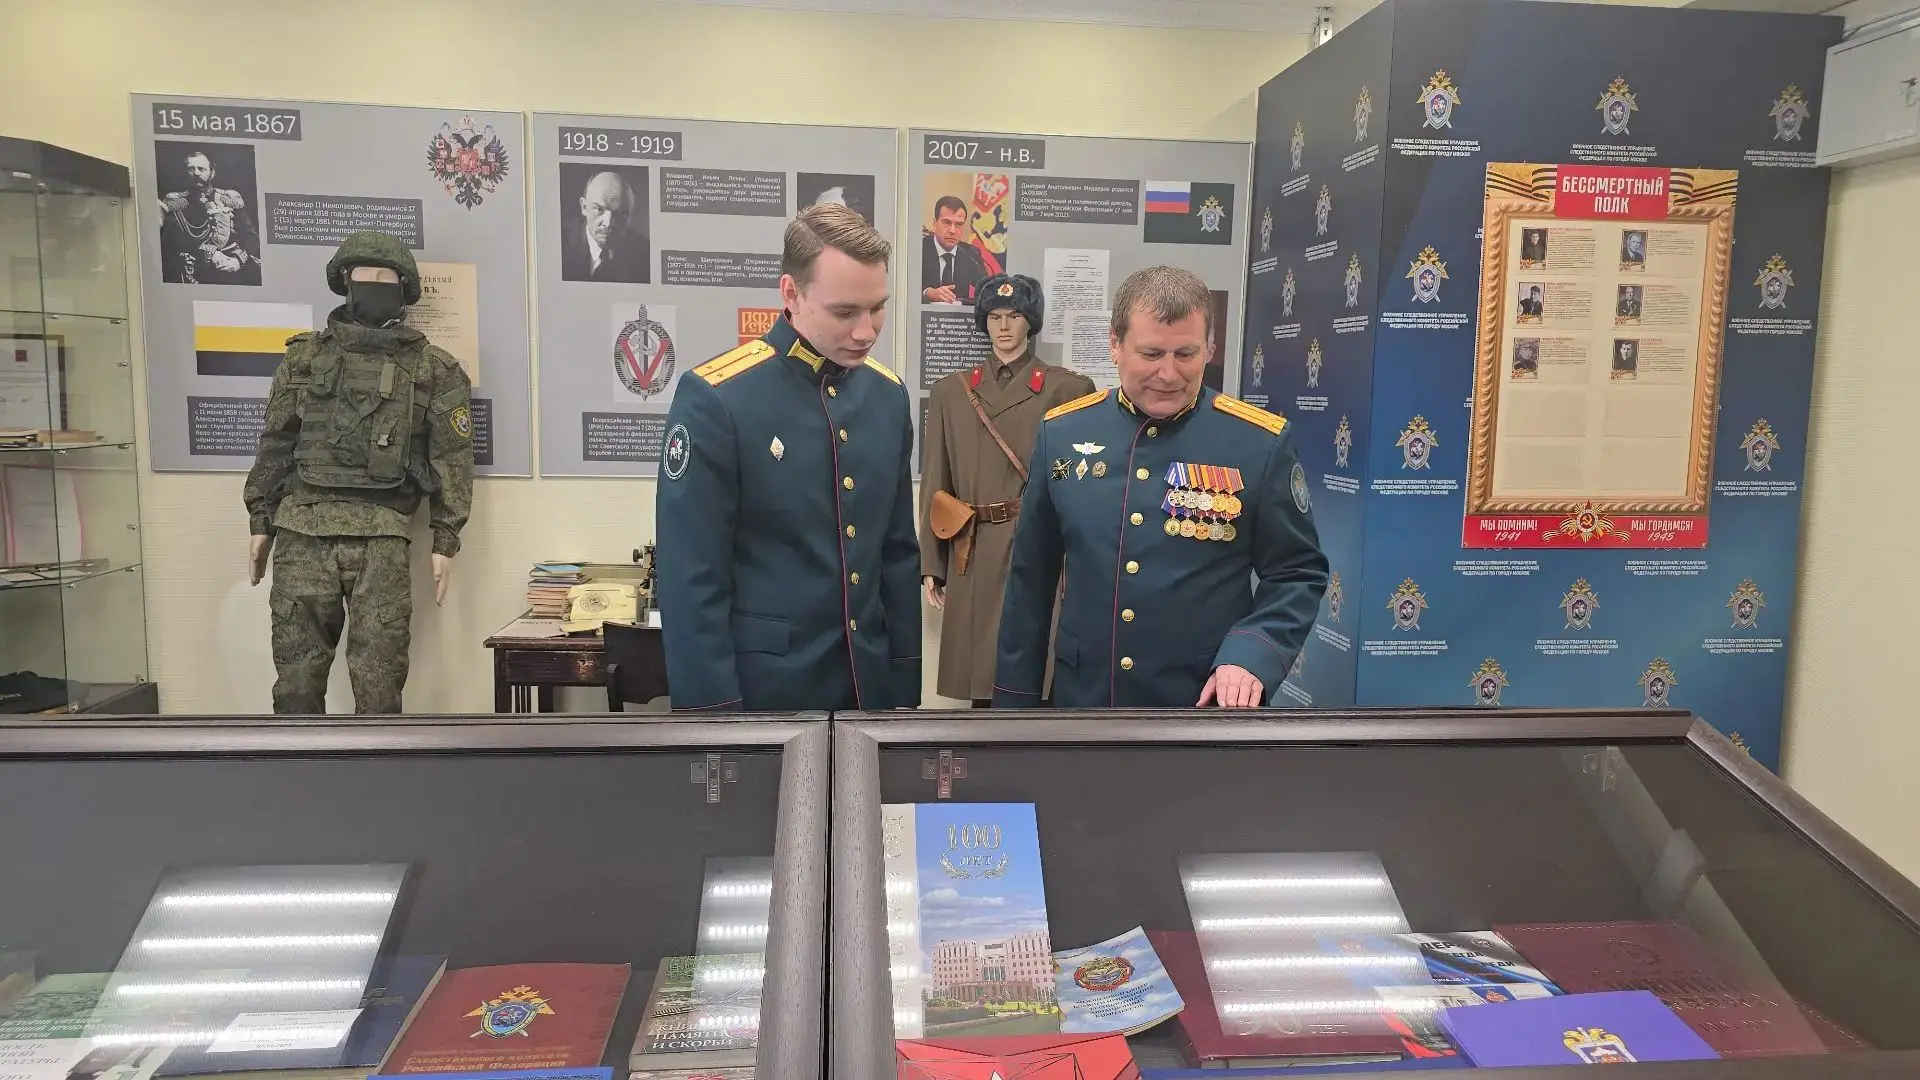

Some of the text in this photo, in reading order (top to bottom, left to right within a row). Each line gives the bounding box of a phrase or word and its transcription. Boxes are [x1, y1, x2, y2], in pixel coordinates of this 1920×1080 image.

[159, 109, 296, 134] 15 мая 1867
[564, 132, 674, 155] 1918 1919
[929, 141, 979, 160] 2007
[1562, 176, 1664, 195] БЕССМЕРТНЫЙ
[1594, 196, 1630, 213] ПОЛК
[273, 208, 286, 216] (29)
[1480, 519, 1538, 531] МЫ ПОМНИМ!
[1631, 519, 1693, 532] МЫ ГОРДИМСЯ!
[1495, 531, 1521, 541] 1941
[1648, 531, 1675, 541] 1945
[946, 823, 1001, 850] 100
[959, 855, 993, 866] ЛЕТ
[655, 1029, 728, 1040] ПАМЯТИ
[668, 1038, 732, 1049] СКОРБИ
